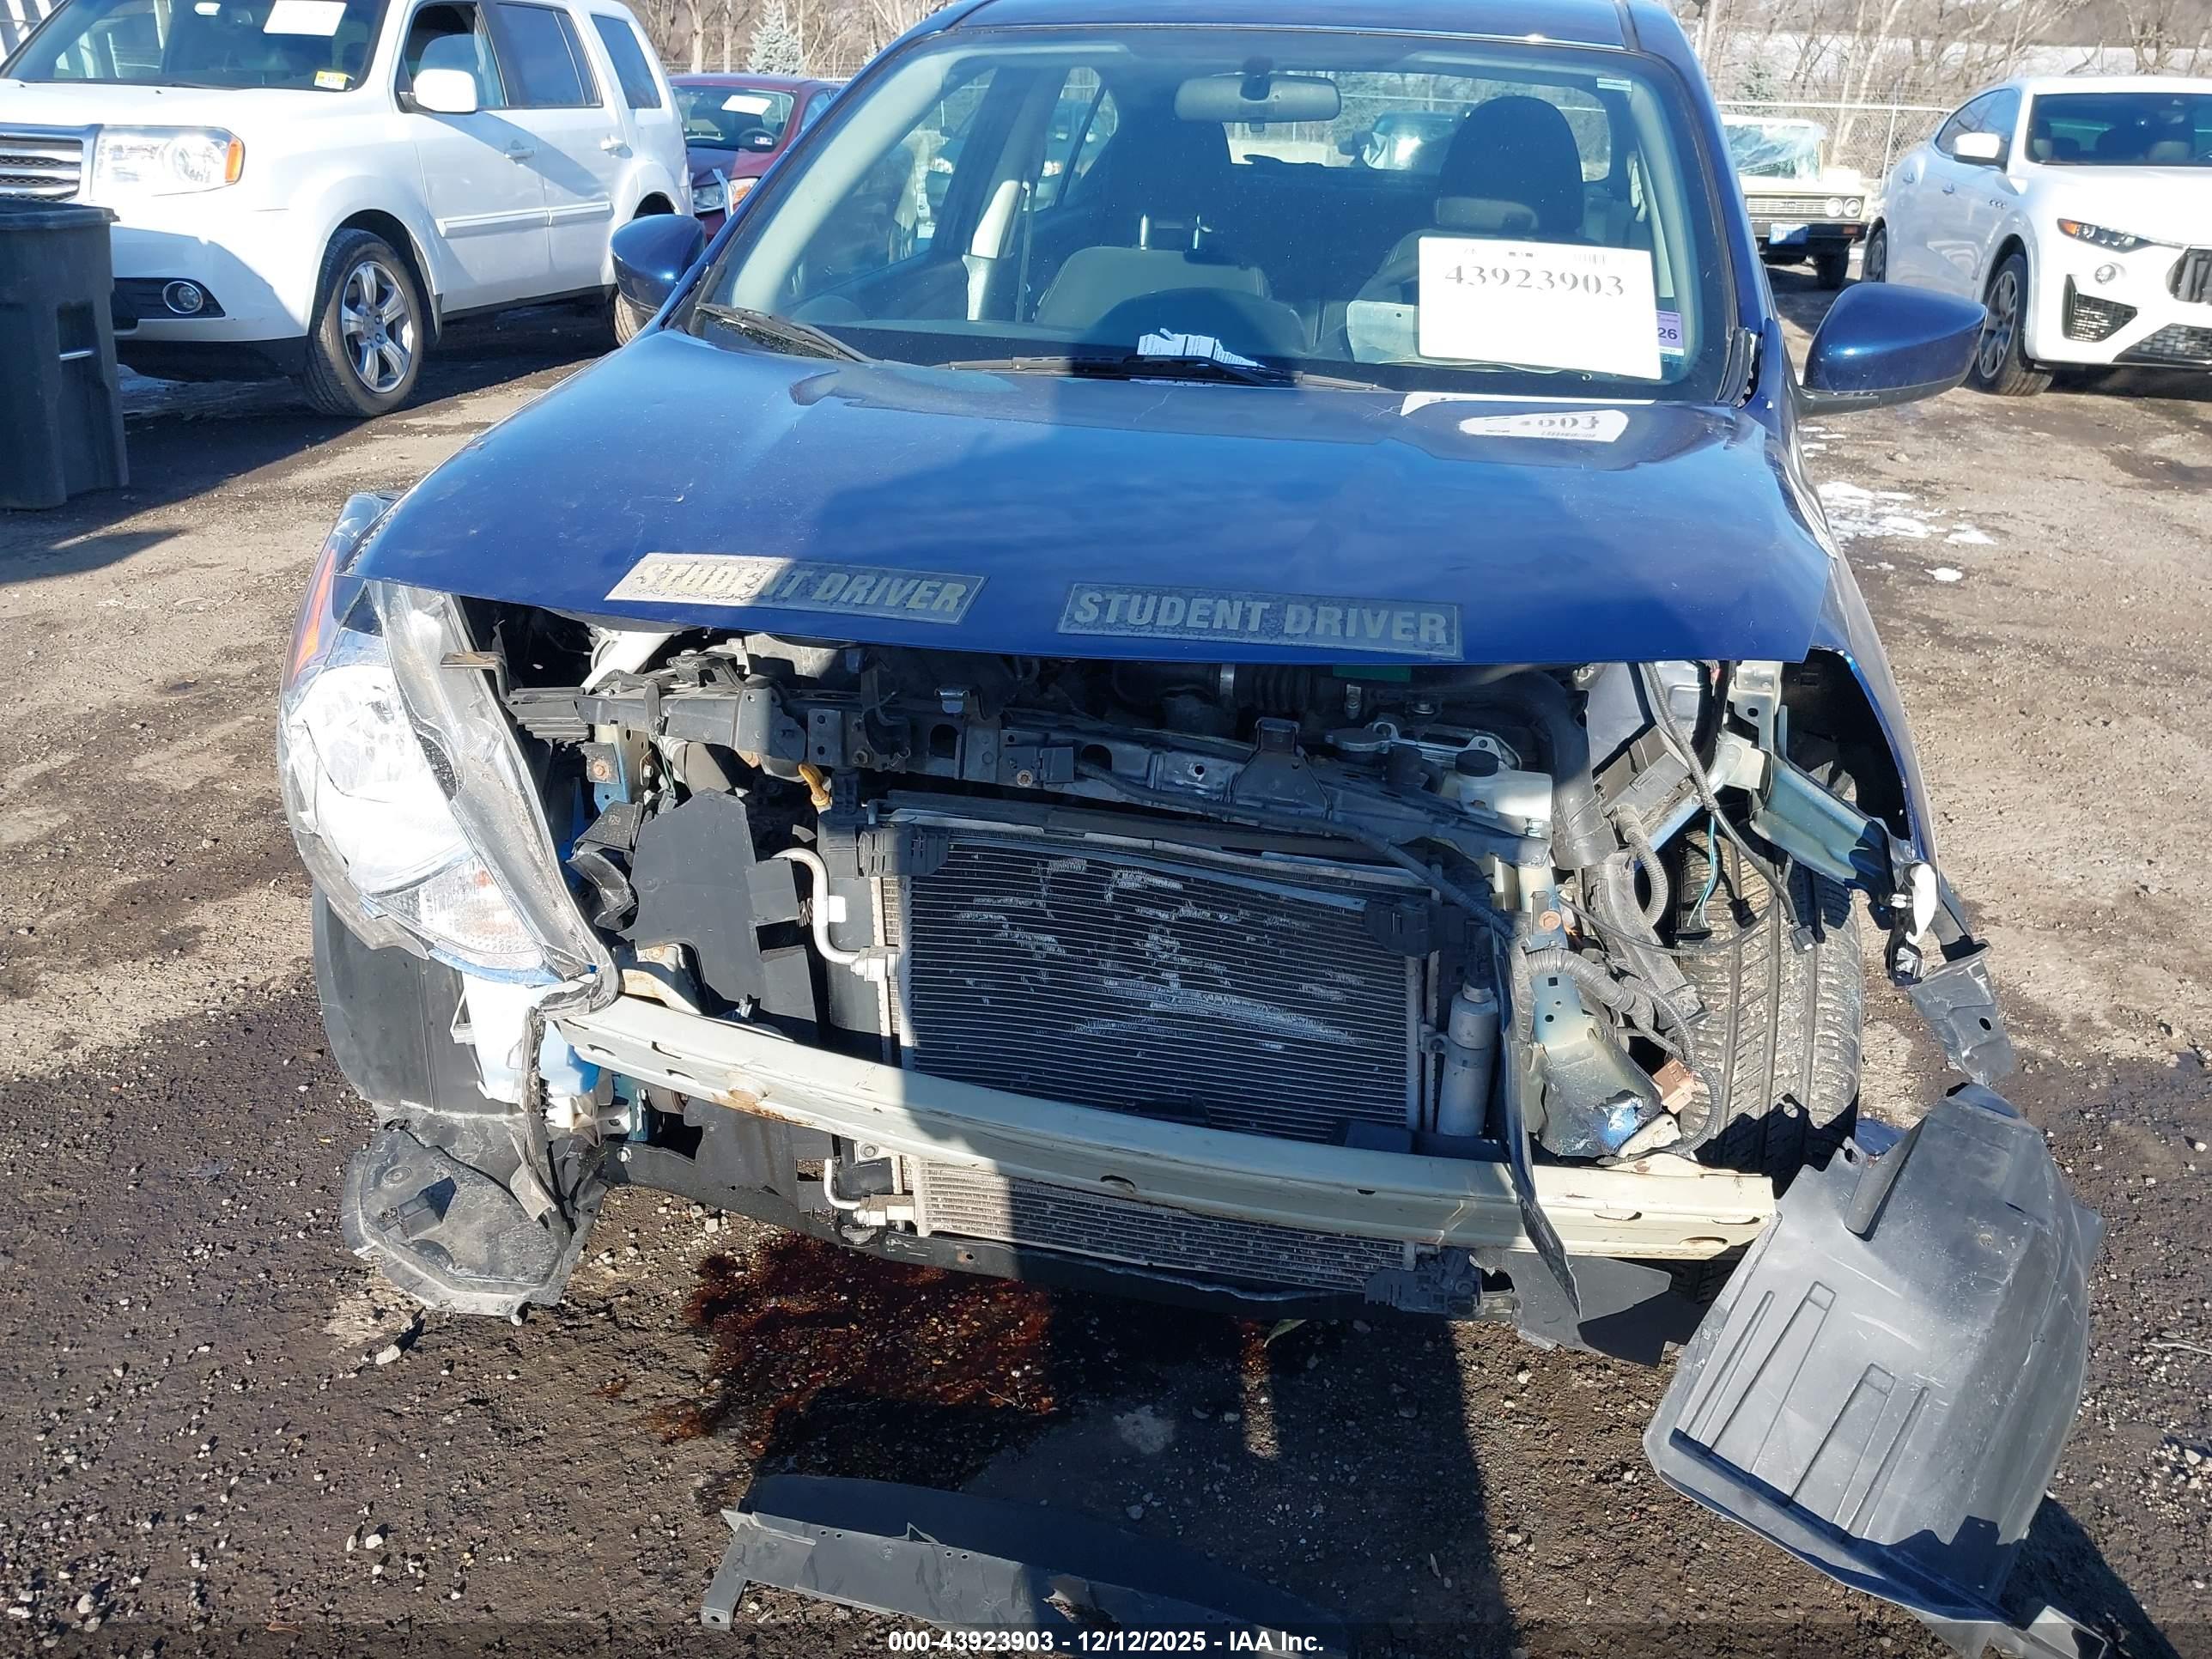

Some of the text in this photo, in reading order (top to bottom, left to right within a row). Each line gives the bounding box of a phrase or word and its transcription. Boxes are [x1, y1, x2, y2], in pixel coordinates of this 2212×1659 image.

[1444, 264, 1625, 297] 43923903
[635, 560, 969, 612] STUDENT DRIVER
[1073, 591, 1448, 644] STUDENT DRIVER
